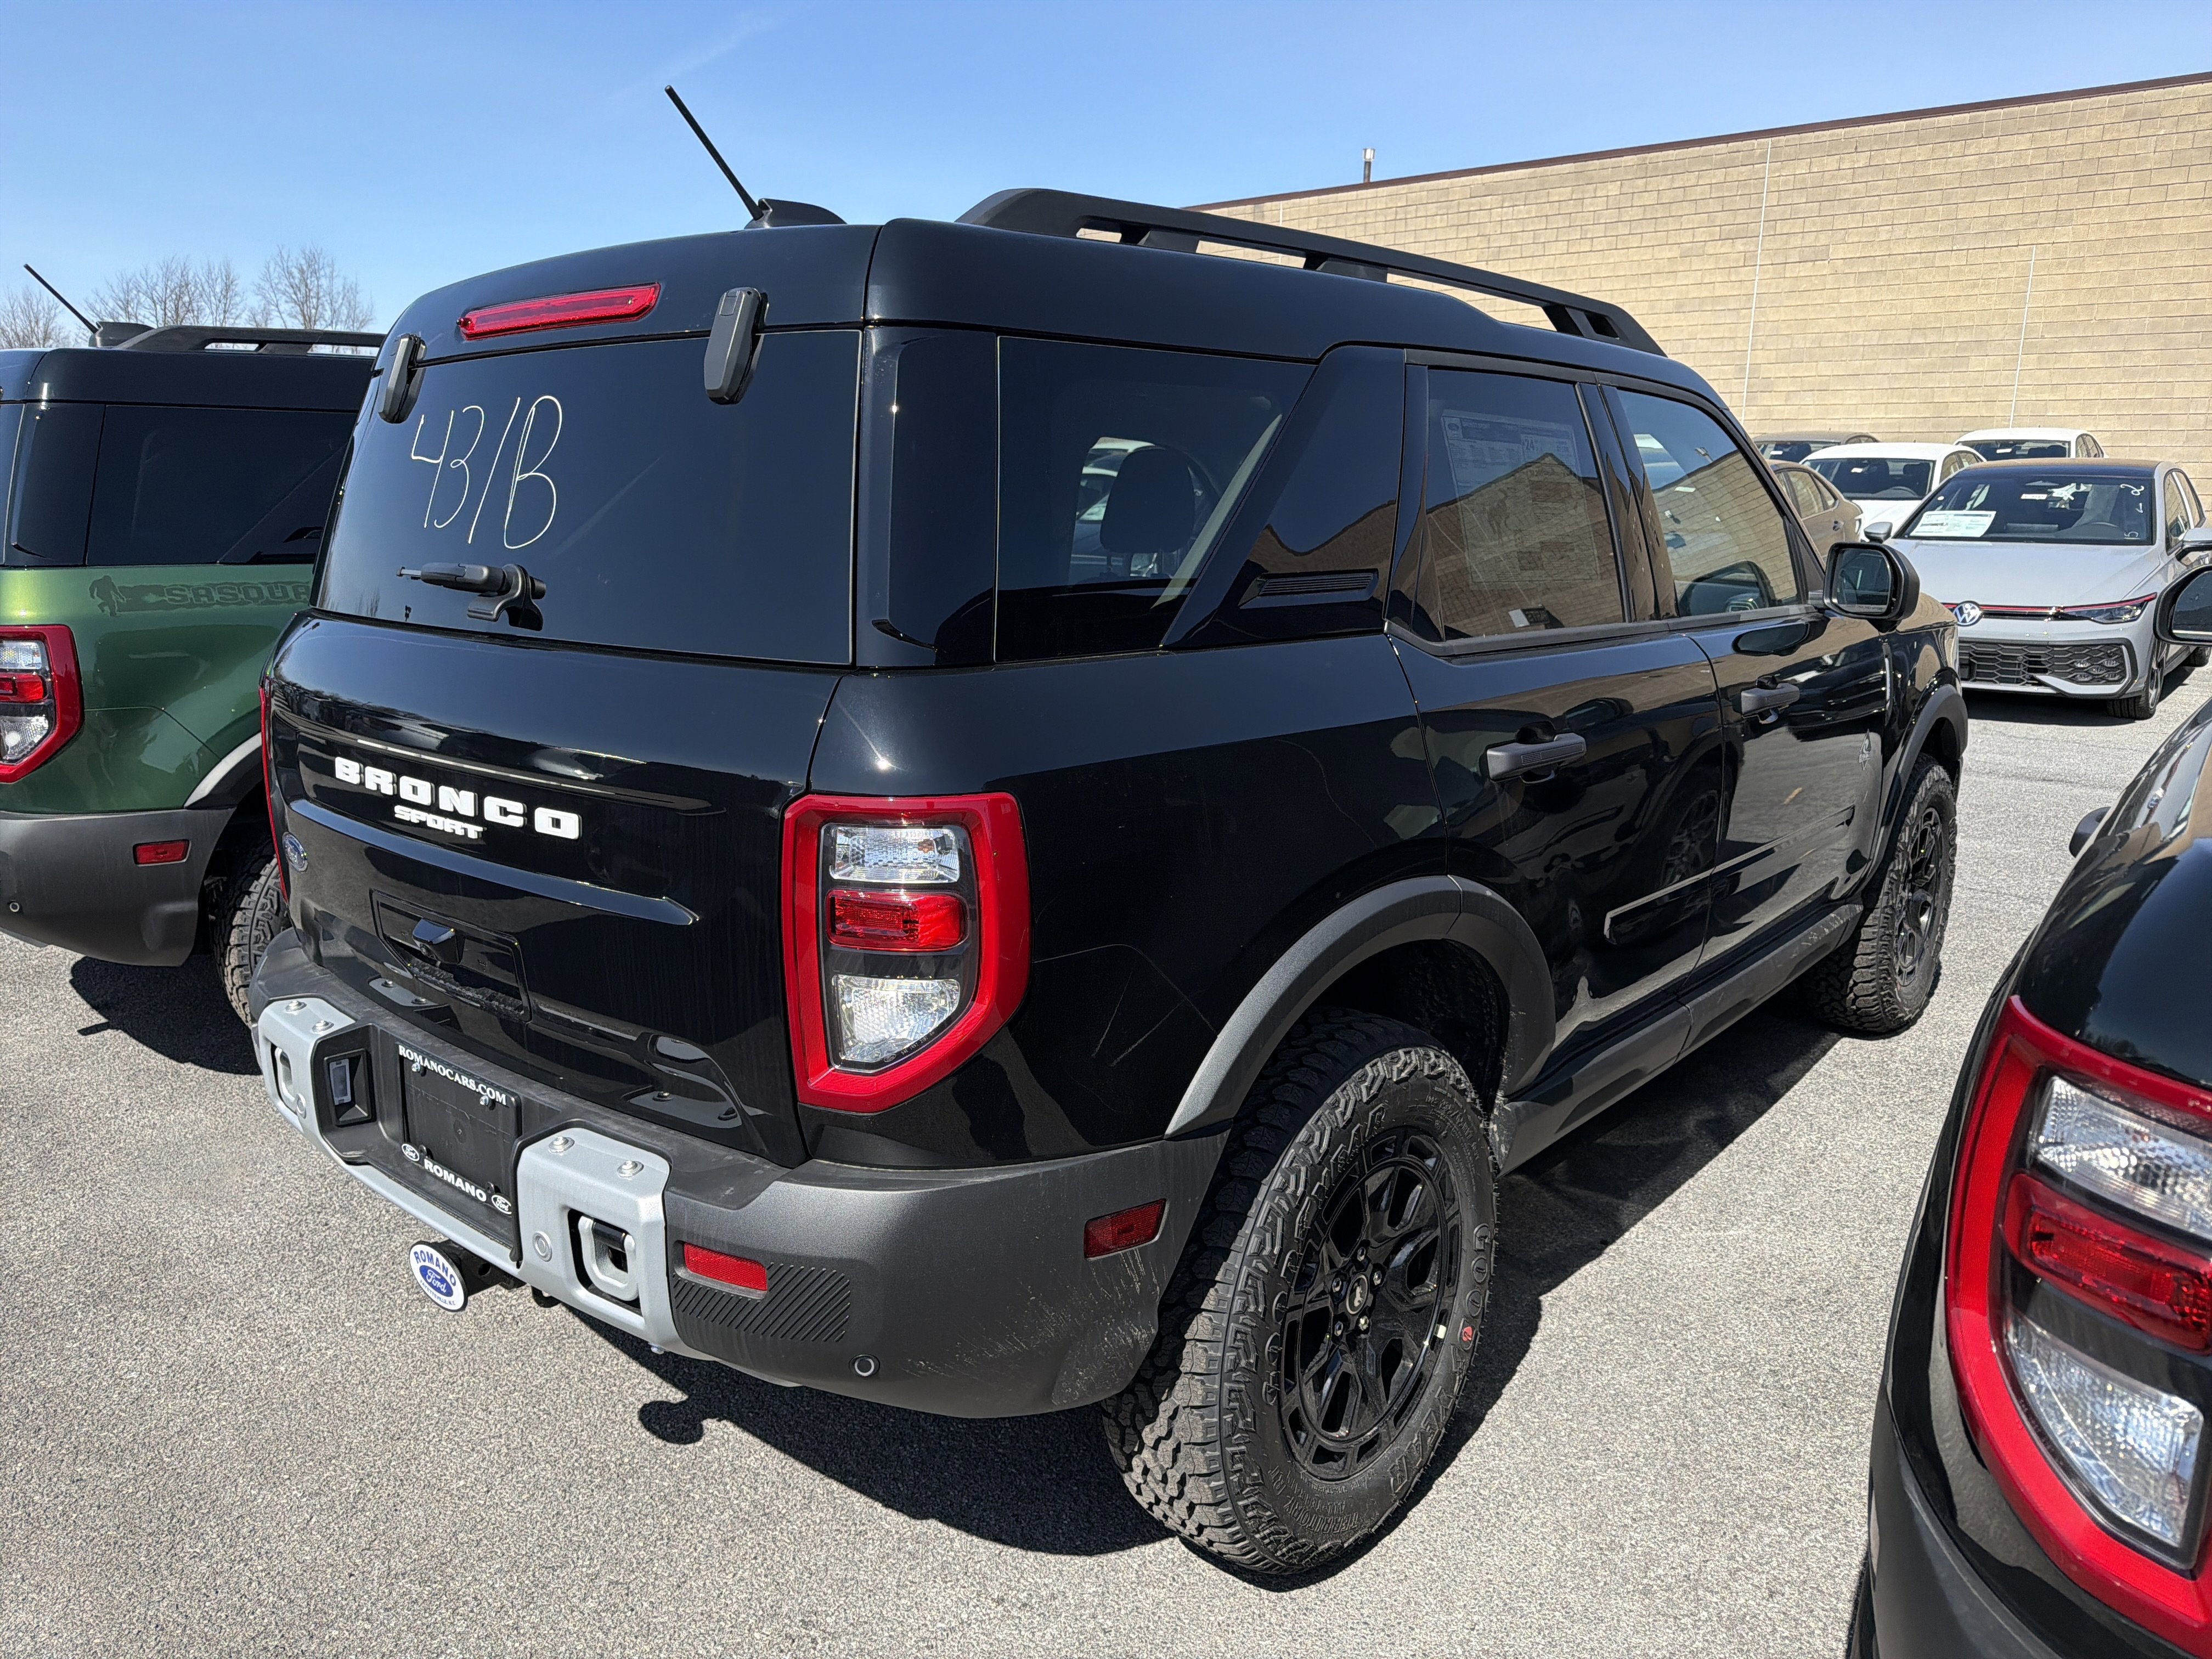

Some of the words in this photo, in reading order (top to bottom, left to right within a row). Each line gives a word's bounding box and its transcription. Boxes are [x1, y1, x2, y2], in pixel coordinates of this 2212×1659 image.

[335, 757, 583, 840] BRONCO
[394, 805, 487, 839] SPORT
[398, 1045, 507, 1105] ROMANOCARS.COM
[424, 1158, 487, 1202] ROMANO
[413, 1250, 456, 1286] ROMANO
[426, 1269, 447, 1293] Ford
